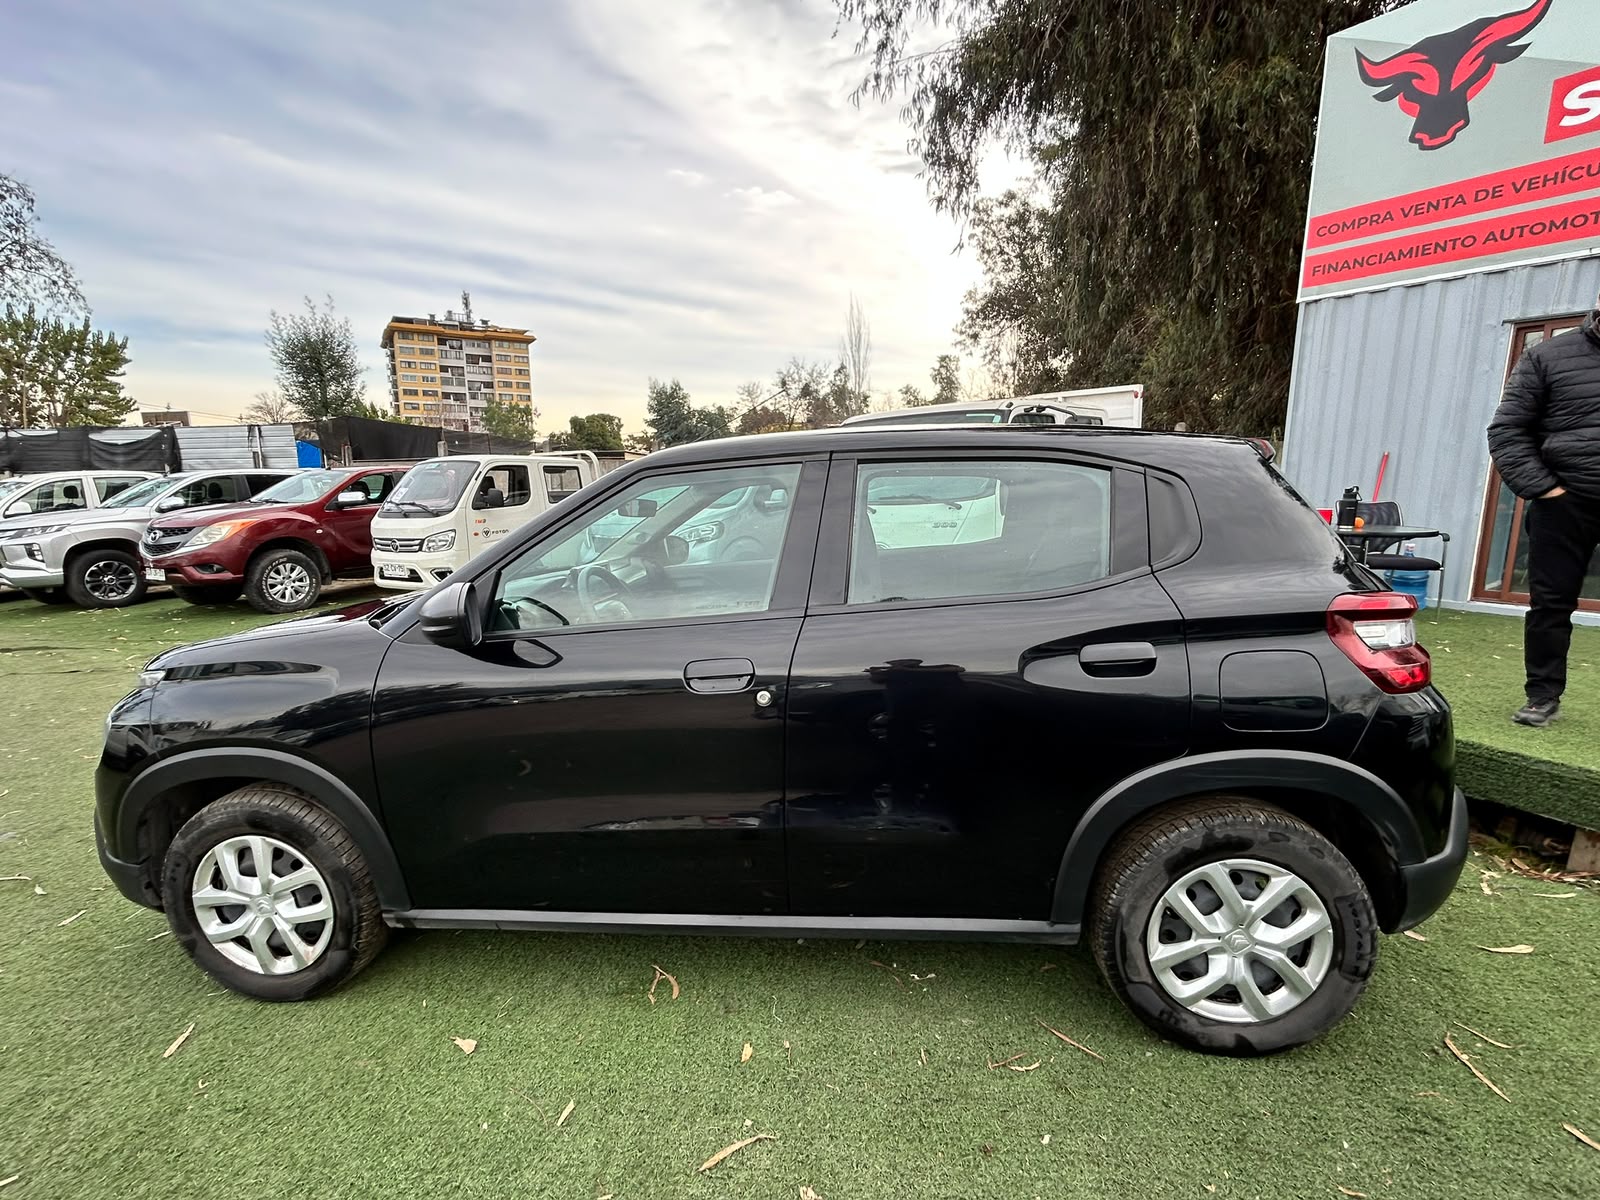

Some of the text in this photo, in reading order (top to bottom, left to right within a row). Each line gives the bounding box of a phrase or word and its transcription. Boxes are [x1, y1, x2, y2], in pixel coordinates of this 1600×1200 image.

[1316, 211, 1394, 238] COMPRA
[1400, 194, 1467, 218] VENTA
[1473, 185, 1504, 202] DE
[1312, 235, 1477, 277] FINANCIAMIENTO
